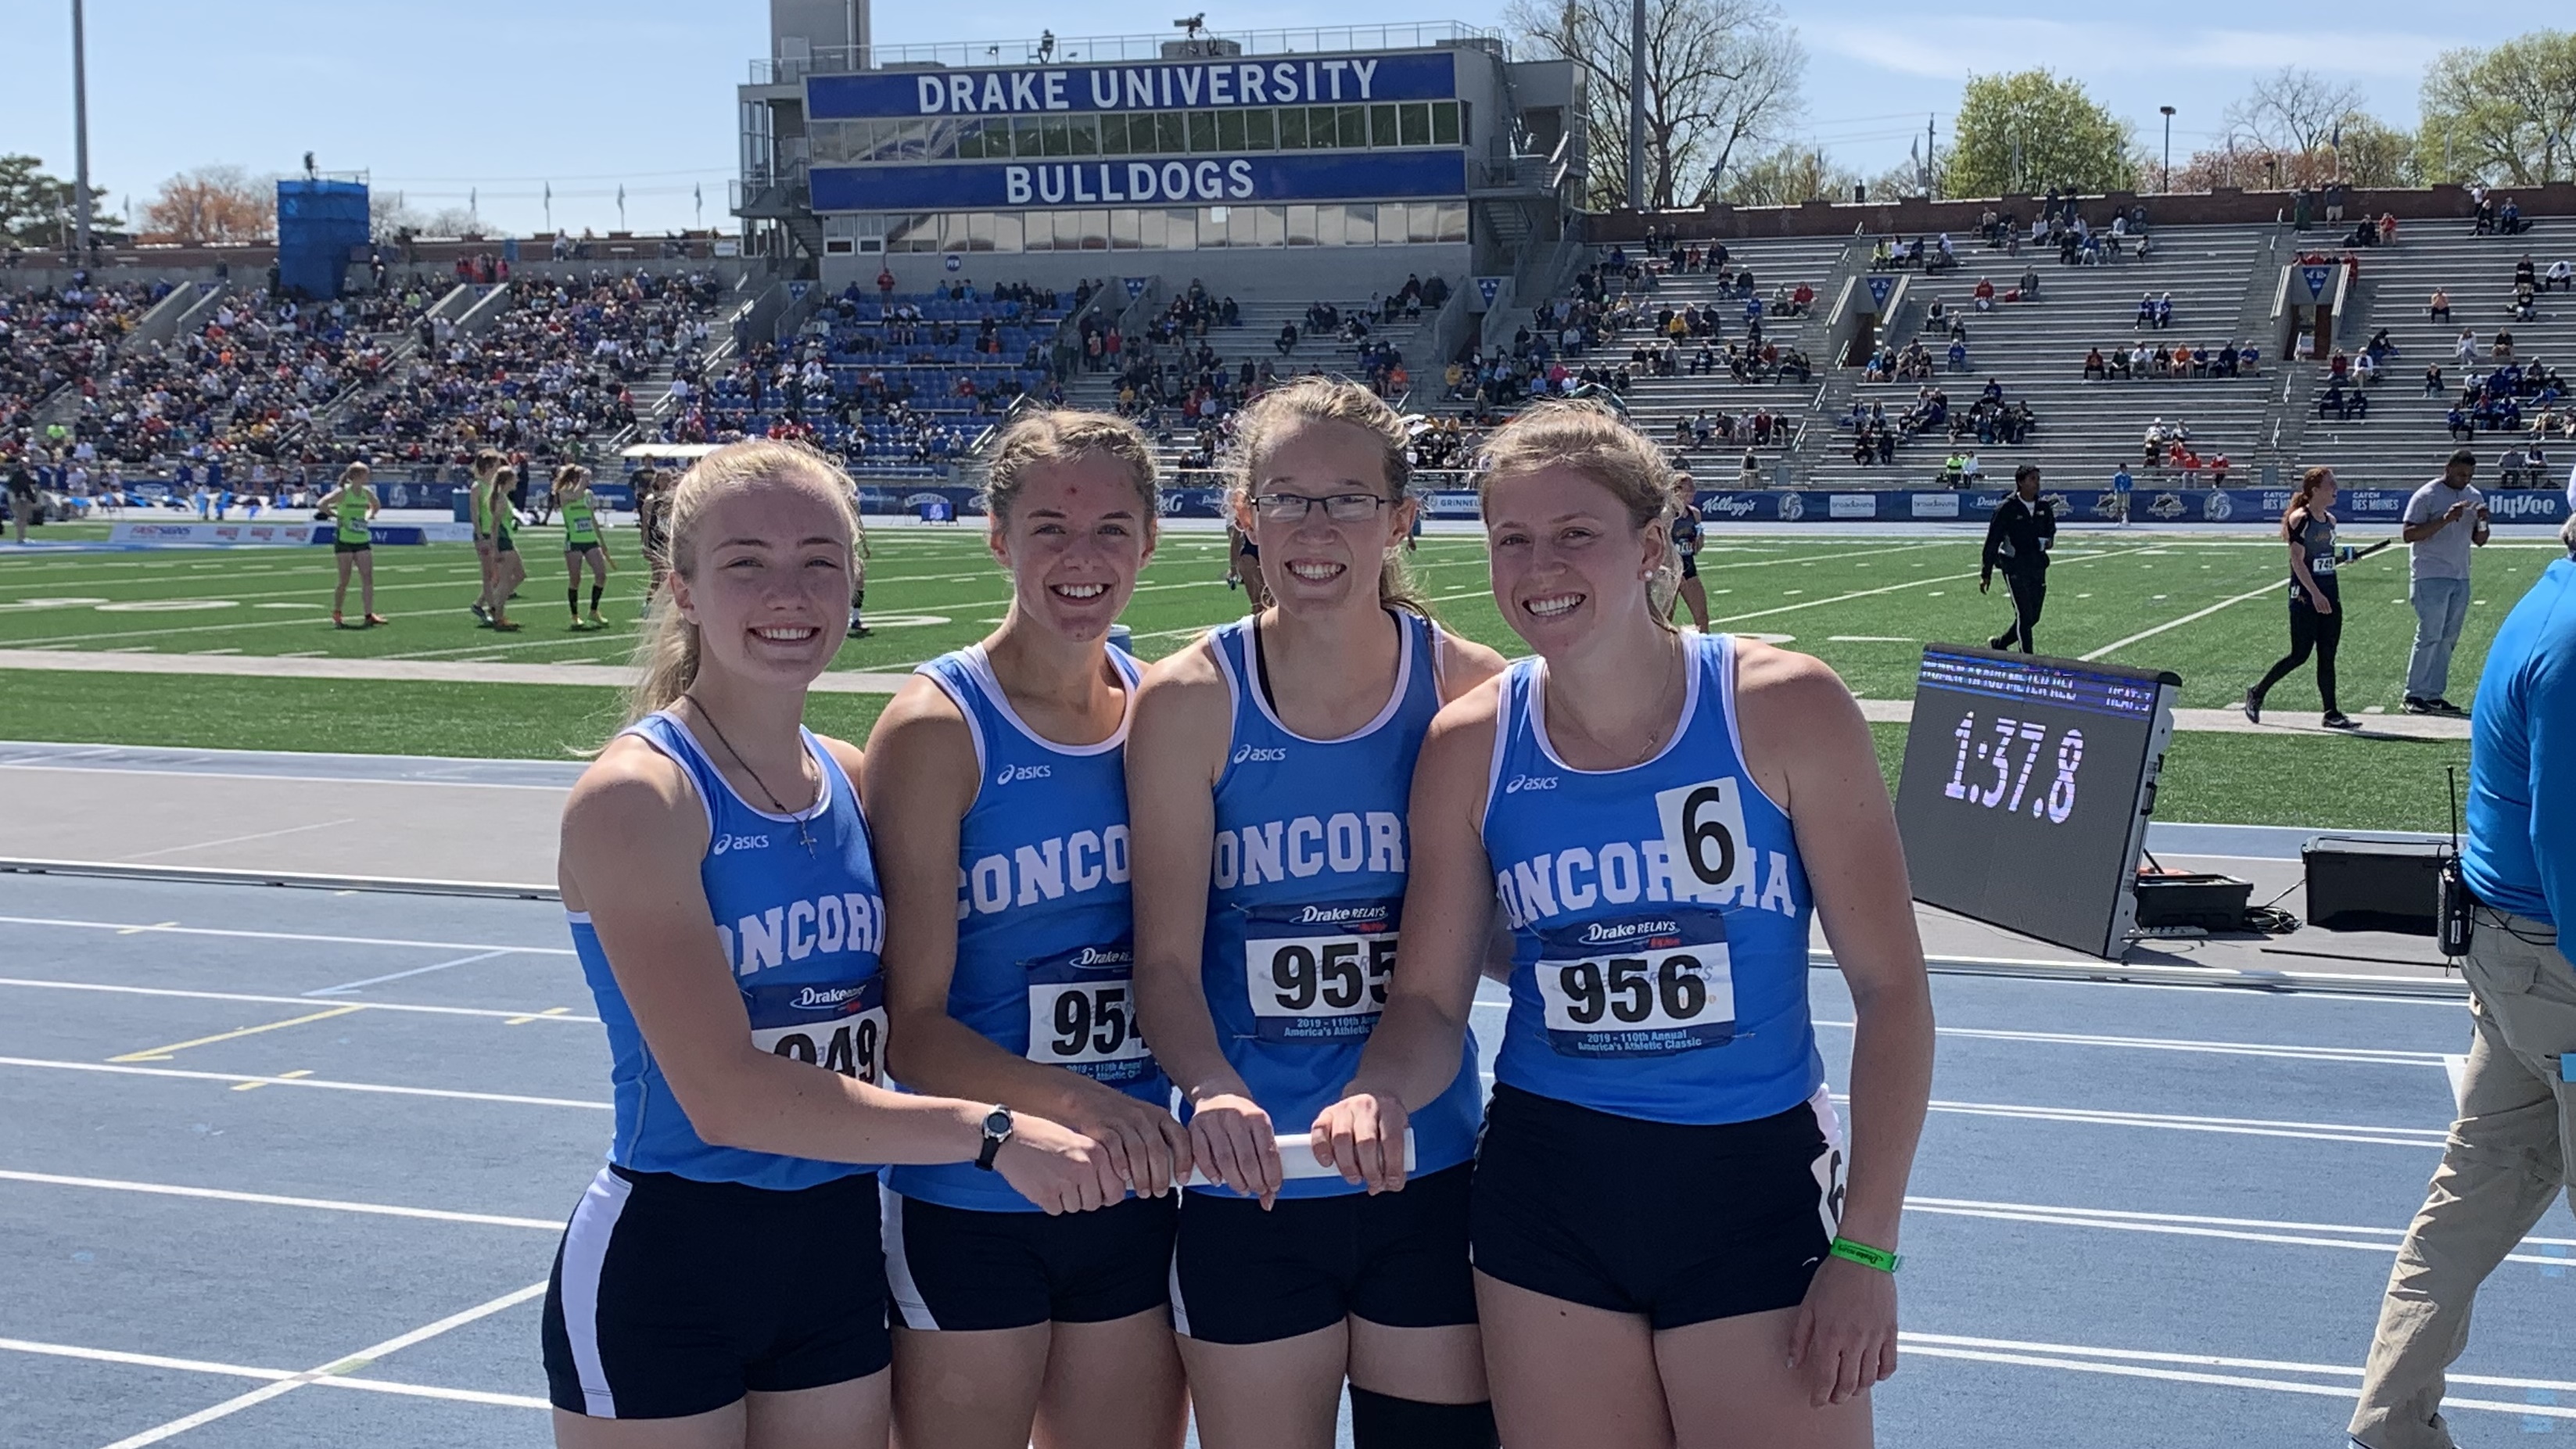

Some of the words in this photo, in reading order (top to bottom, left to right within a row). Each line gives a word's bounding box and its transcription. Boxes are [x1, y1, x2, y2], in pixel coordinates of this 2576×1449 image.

[917, 72, 1070, 113] DRAKE
[1091, 59, 1378, 108] UNIVERSITY
[1006, 160, 1254, 204] BULLDOGS
[1702, 495, 1756, 517] Kellogg's
[2262, 499, 2278, 509] DES
[2352, 499, 2367, 510] DES
[2369, 499, 2399, 511] MOINES
[1250, 748, 1286, 762] asics
[1016, 765, 1051, 780] asics
[1945, 710, 2085, 824] 1:37.8
[1523, 776, 1559, 791] asics
[733, 834, 769, 850] asics
[1682, 786, 1735, 885] 6
[1497, 839, 1796, 930] ONCORIA
[1302, 906, 1351, 923] Drake
[1351, 906, 1387, 919] RELAYS
[1588, 923, 1636, 941] Drake
[1637, 921, 1677, 934] RELAYS
[1081, 948, 1119, 965] Drake
[1272, 940, 1397, 1010] 955
[800, 987, 845, 1005] Drake
[1560, 954, 1706, 1024] 956
[1284, 1027, 1332, 1037] America's
[1333, 1025, 1370, 1036] Athletic
[1297, 1018, 1321, 1028] 2019
[1332, 1017, 1359, 1028] 110th
[1577, 1042, 1623, 1051] America's
[1624, 1040, 1663, 1050] Athletic
[1664, 1037, 1702, 1049] Classic
[1588, 1034, 1611, 1043] 2019
[1620, 1032, 1649, 1042] 110th
[1651, 1029, 1687, 1041] Annual
